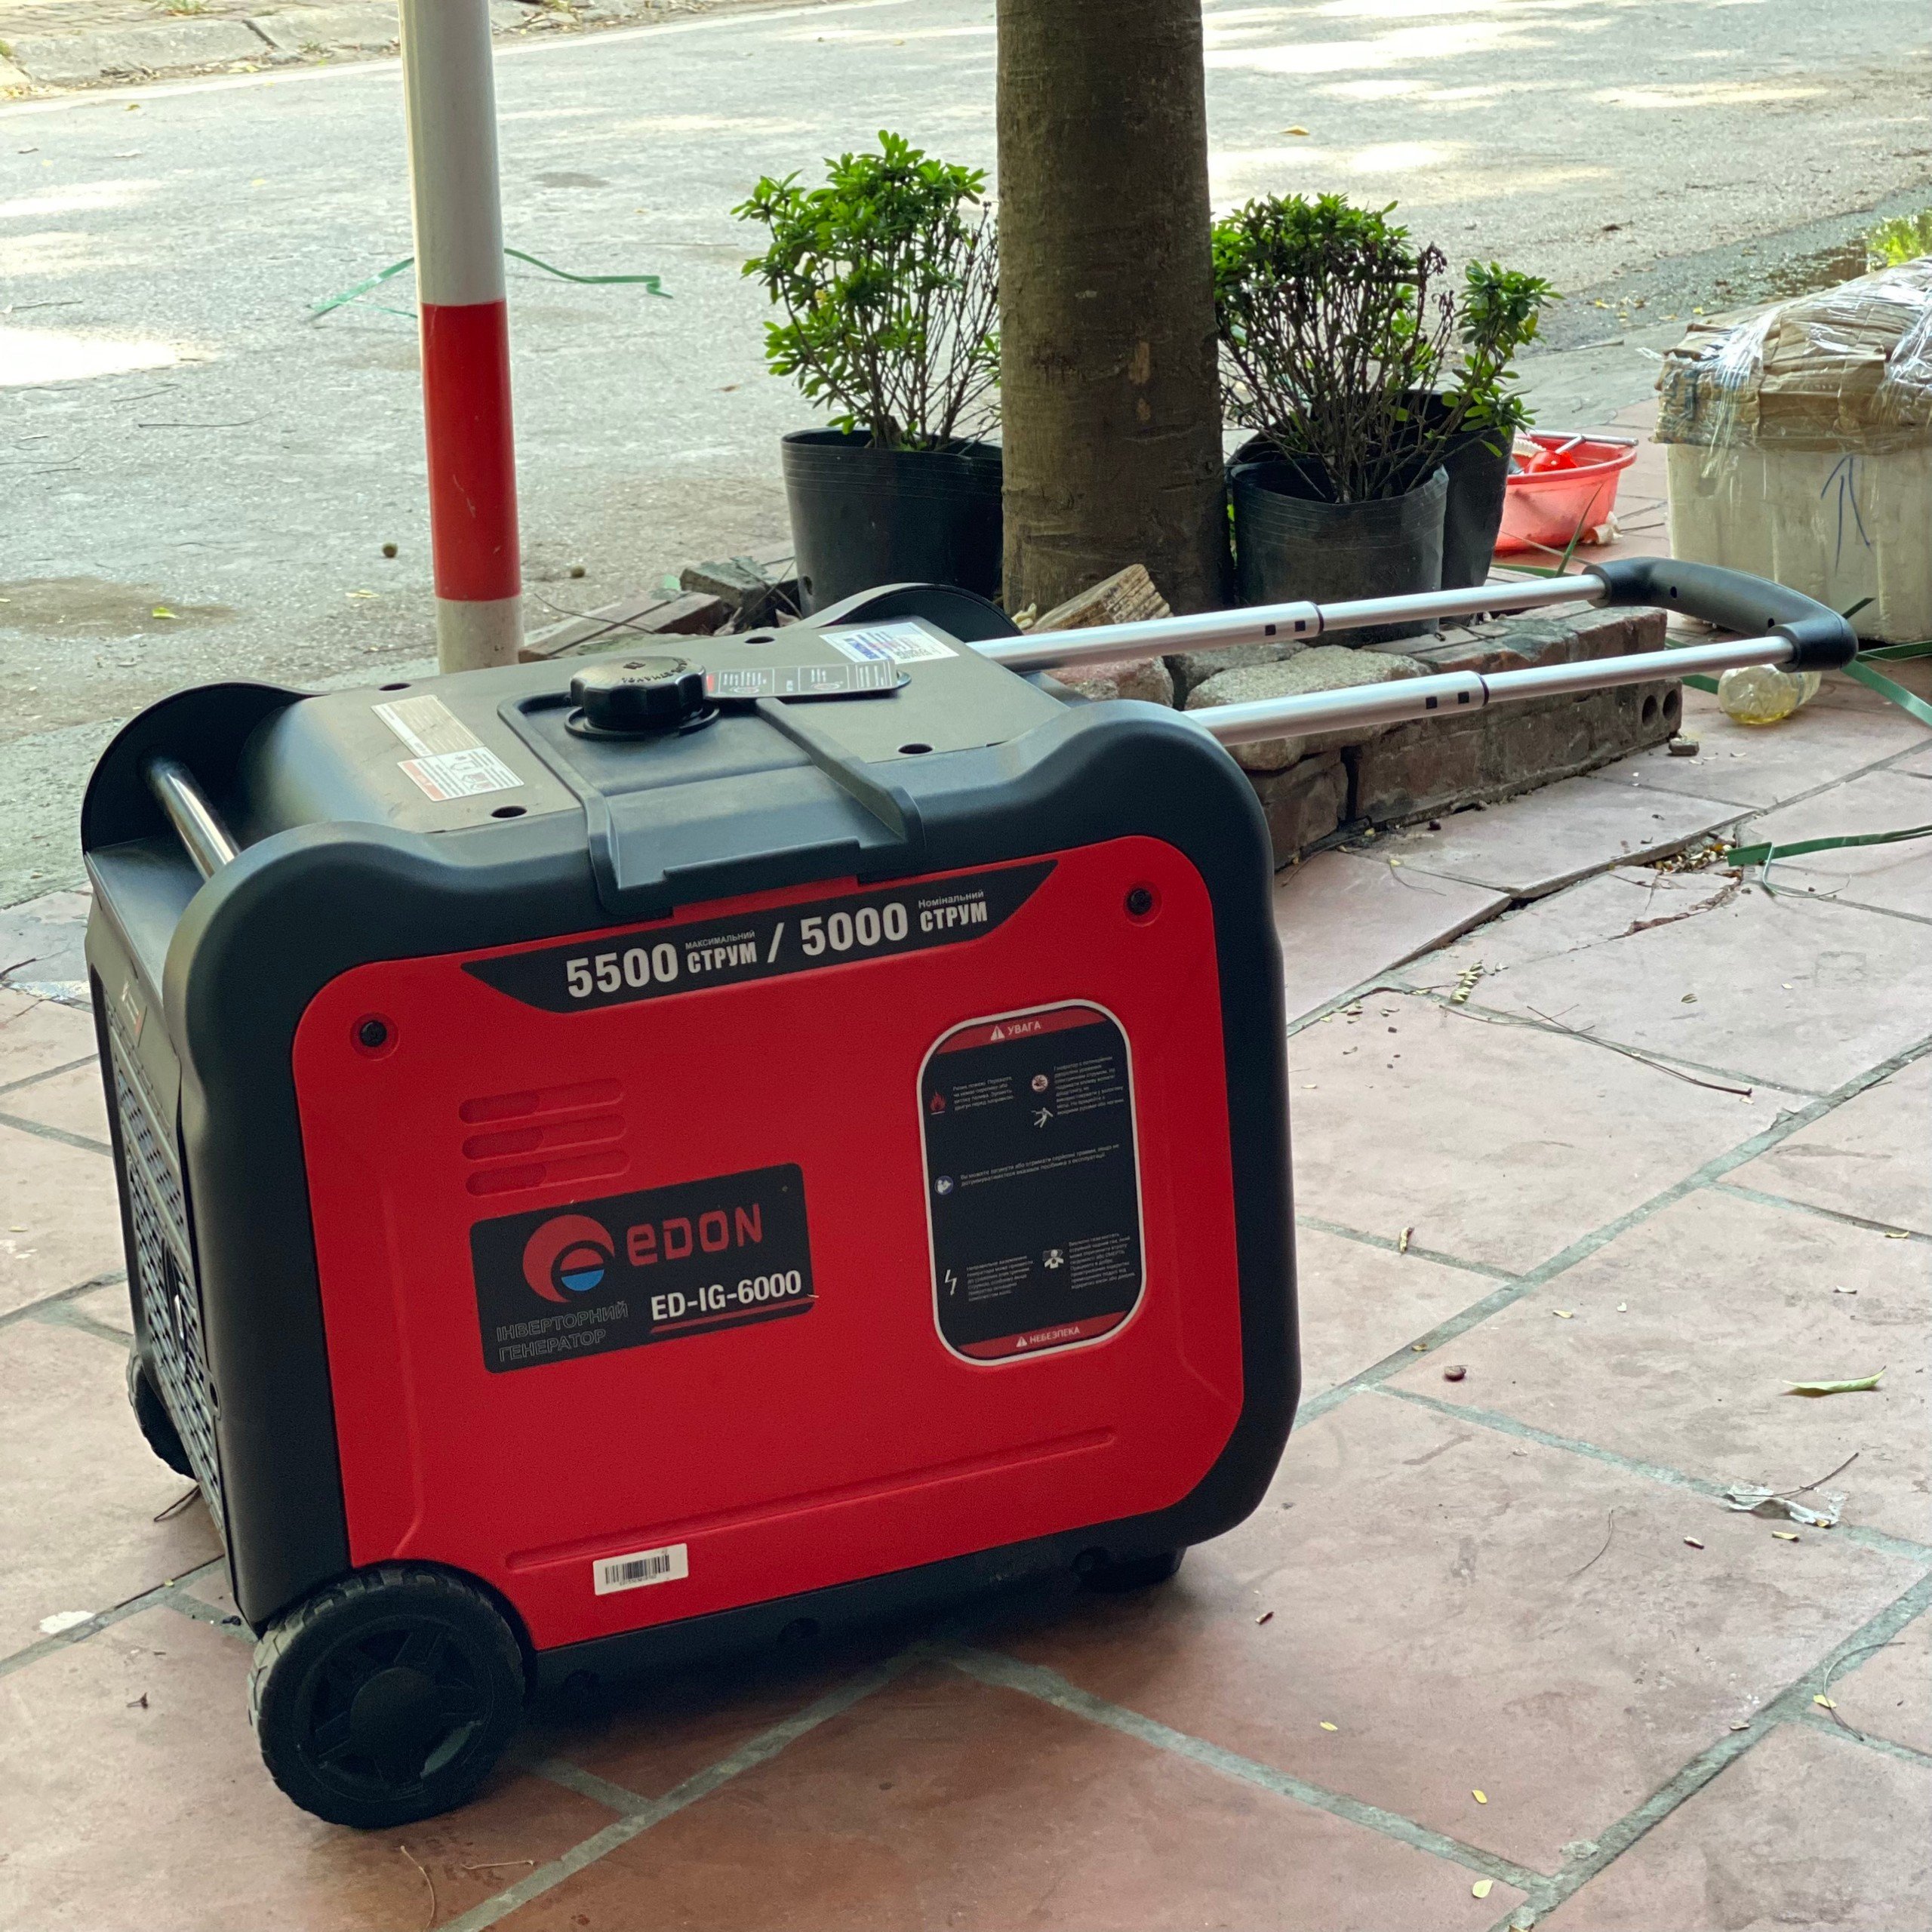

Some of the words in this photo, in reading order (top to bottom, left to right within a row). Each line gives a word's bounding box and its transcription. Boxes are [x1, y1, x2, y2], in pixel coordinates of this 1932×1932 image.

[918, 890, 984, 909] Номінальний
[566, 943, 679, 998] 5500
[687, 942, 757, 974] СТРУМ
[767, 921, 785, 963] /
[800, 902, 909, 956] 5000
[919, 901, 988, 932] СТРУМ
[685, 930, 755, 950] МАКСИМАЛЬНИЙ
[1008, 1021, 1041, 1035] УВАГА
[651, 1270, 802, 1321] ED-IG-6000
[496, 1300, 629, 1342] ІНВЕРТОРНИЙ
[1029, 1325, 1081, 1344] НЕБЕЗПЕКА
[499, 1328, 607, 1362] ГЕНЕРАТОР
